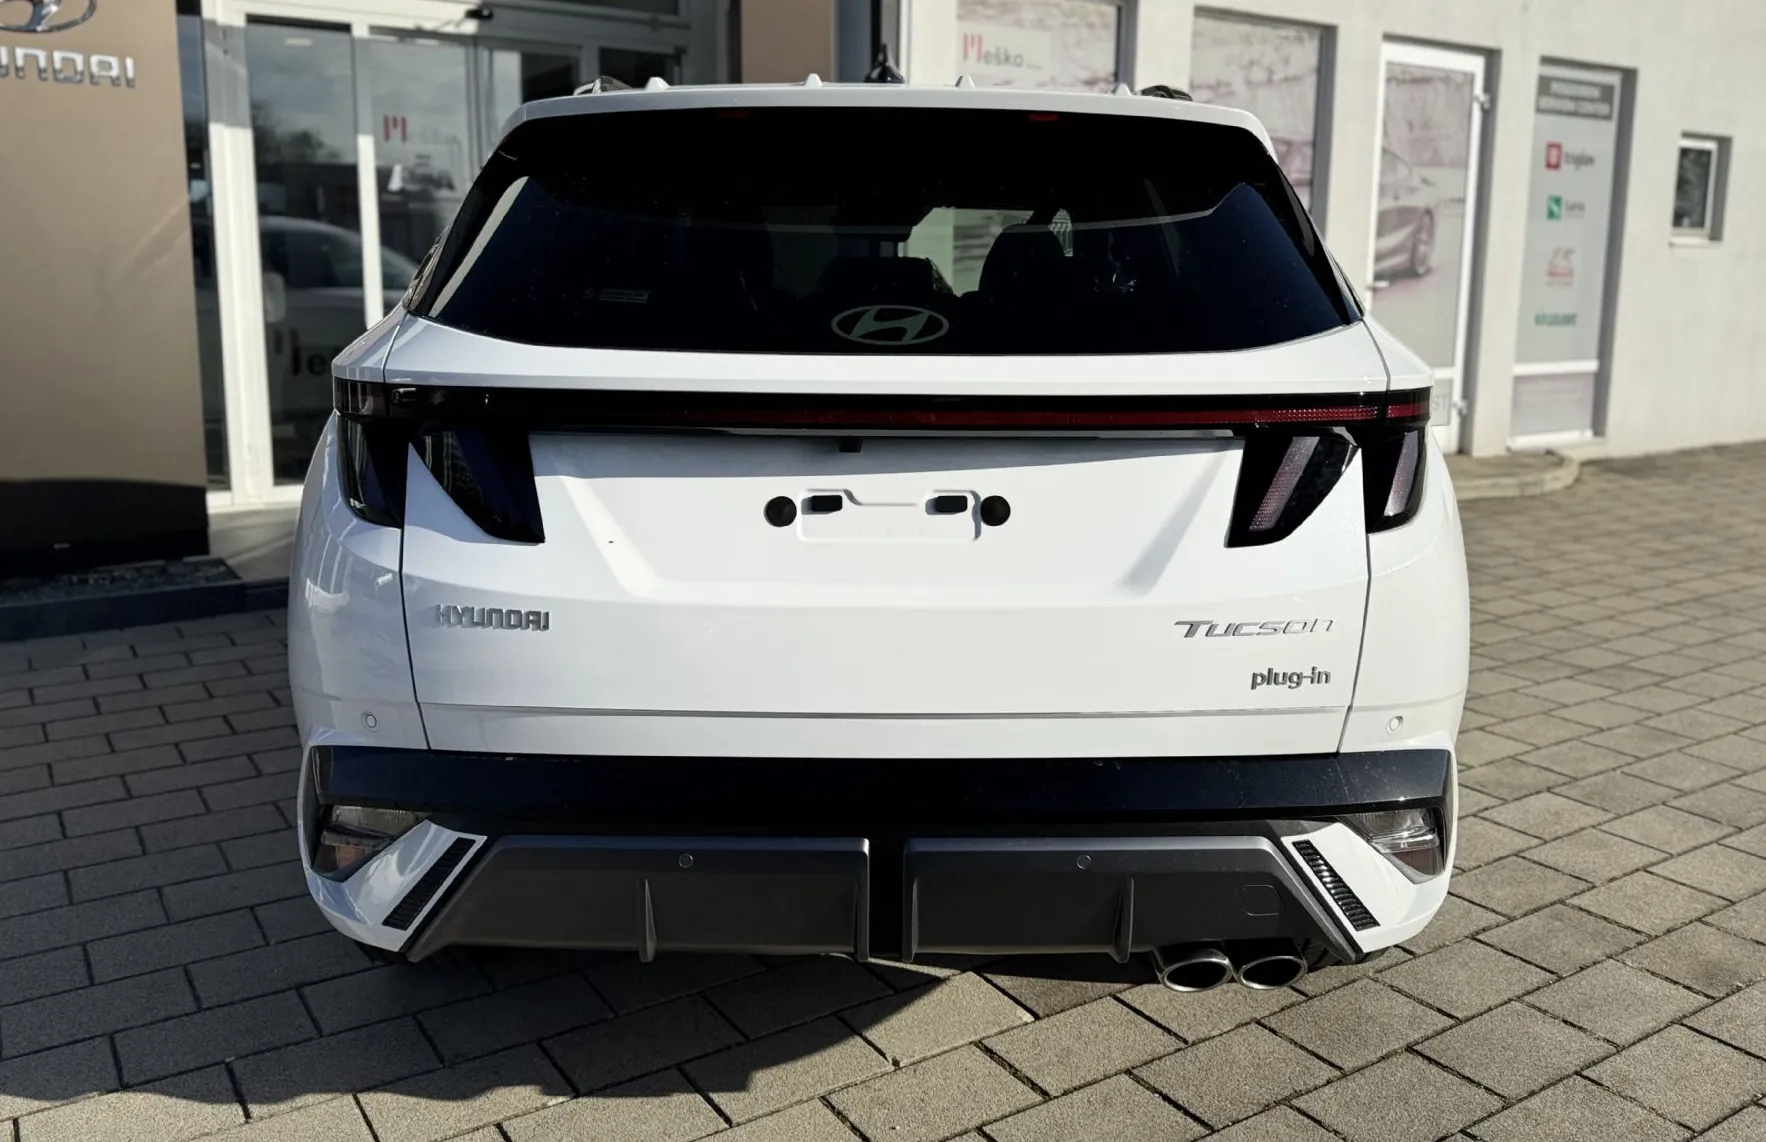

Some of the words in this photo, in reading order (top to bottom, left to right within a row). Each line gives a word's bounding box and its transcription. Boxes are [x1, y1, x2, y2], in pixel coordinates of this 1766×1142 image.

[0, 46, 136, 89] NDAI
[435, 604, 550, 632] HYUNDAI
[1250, 666, 1332, 690] plug-in
